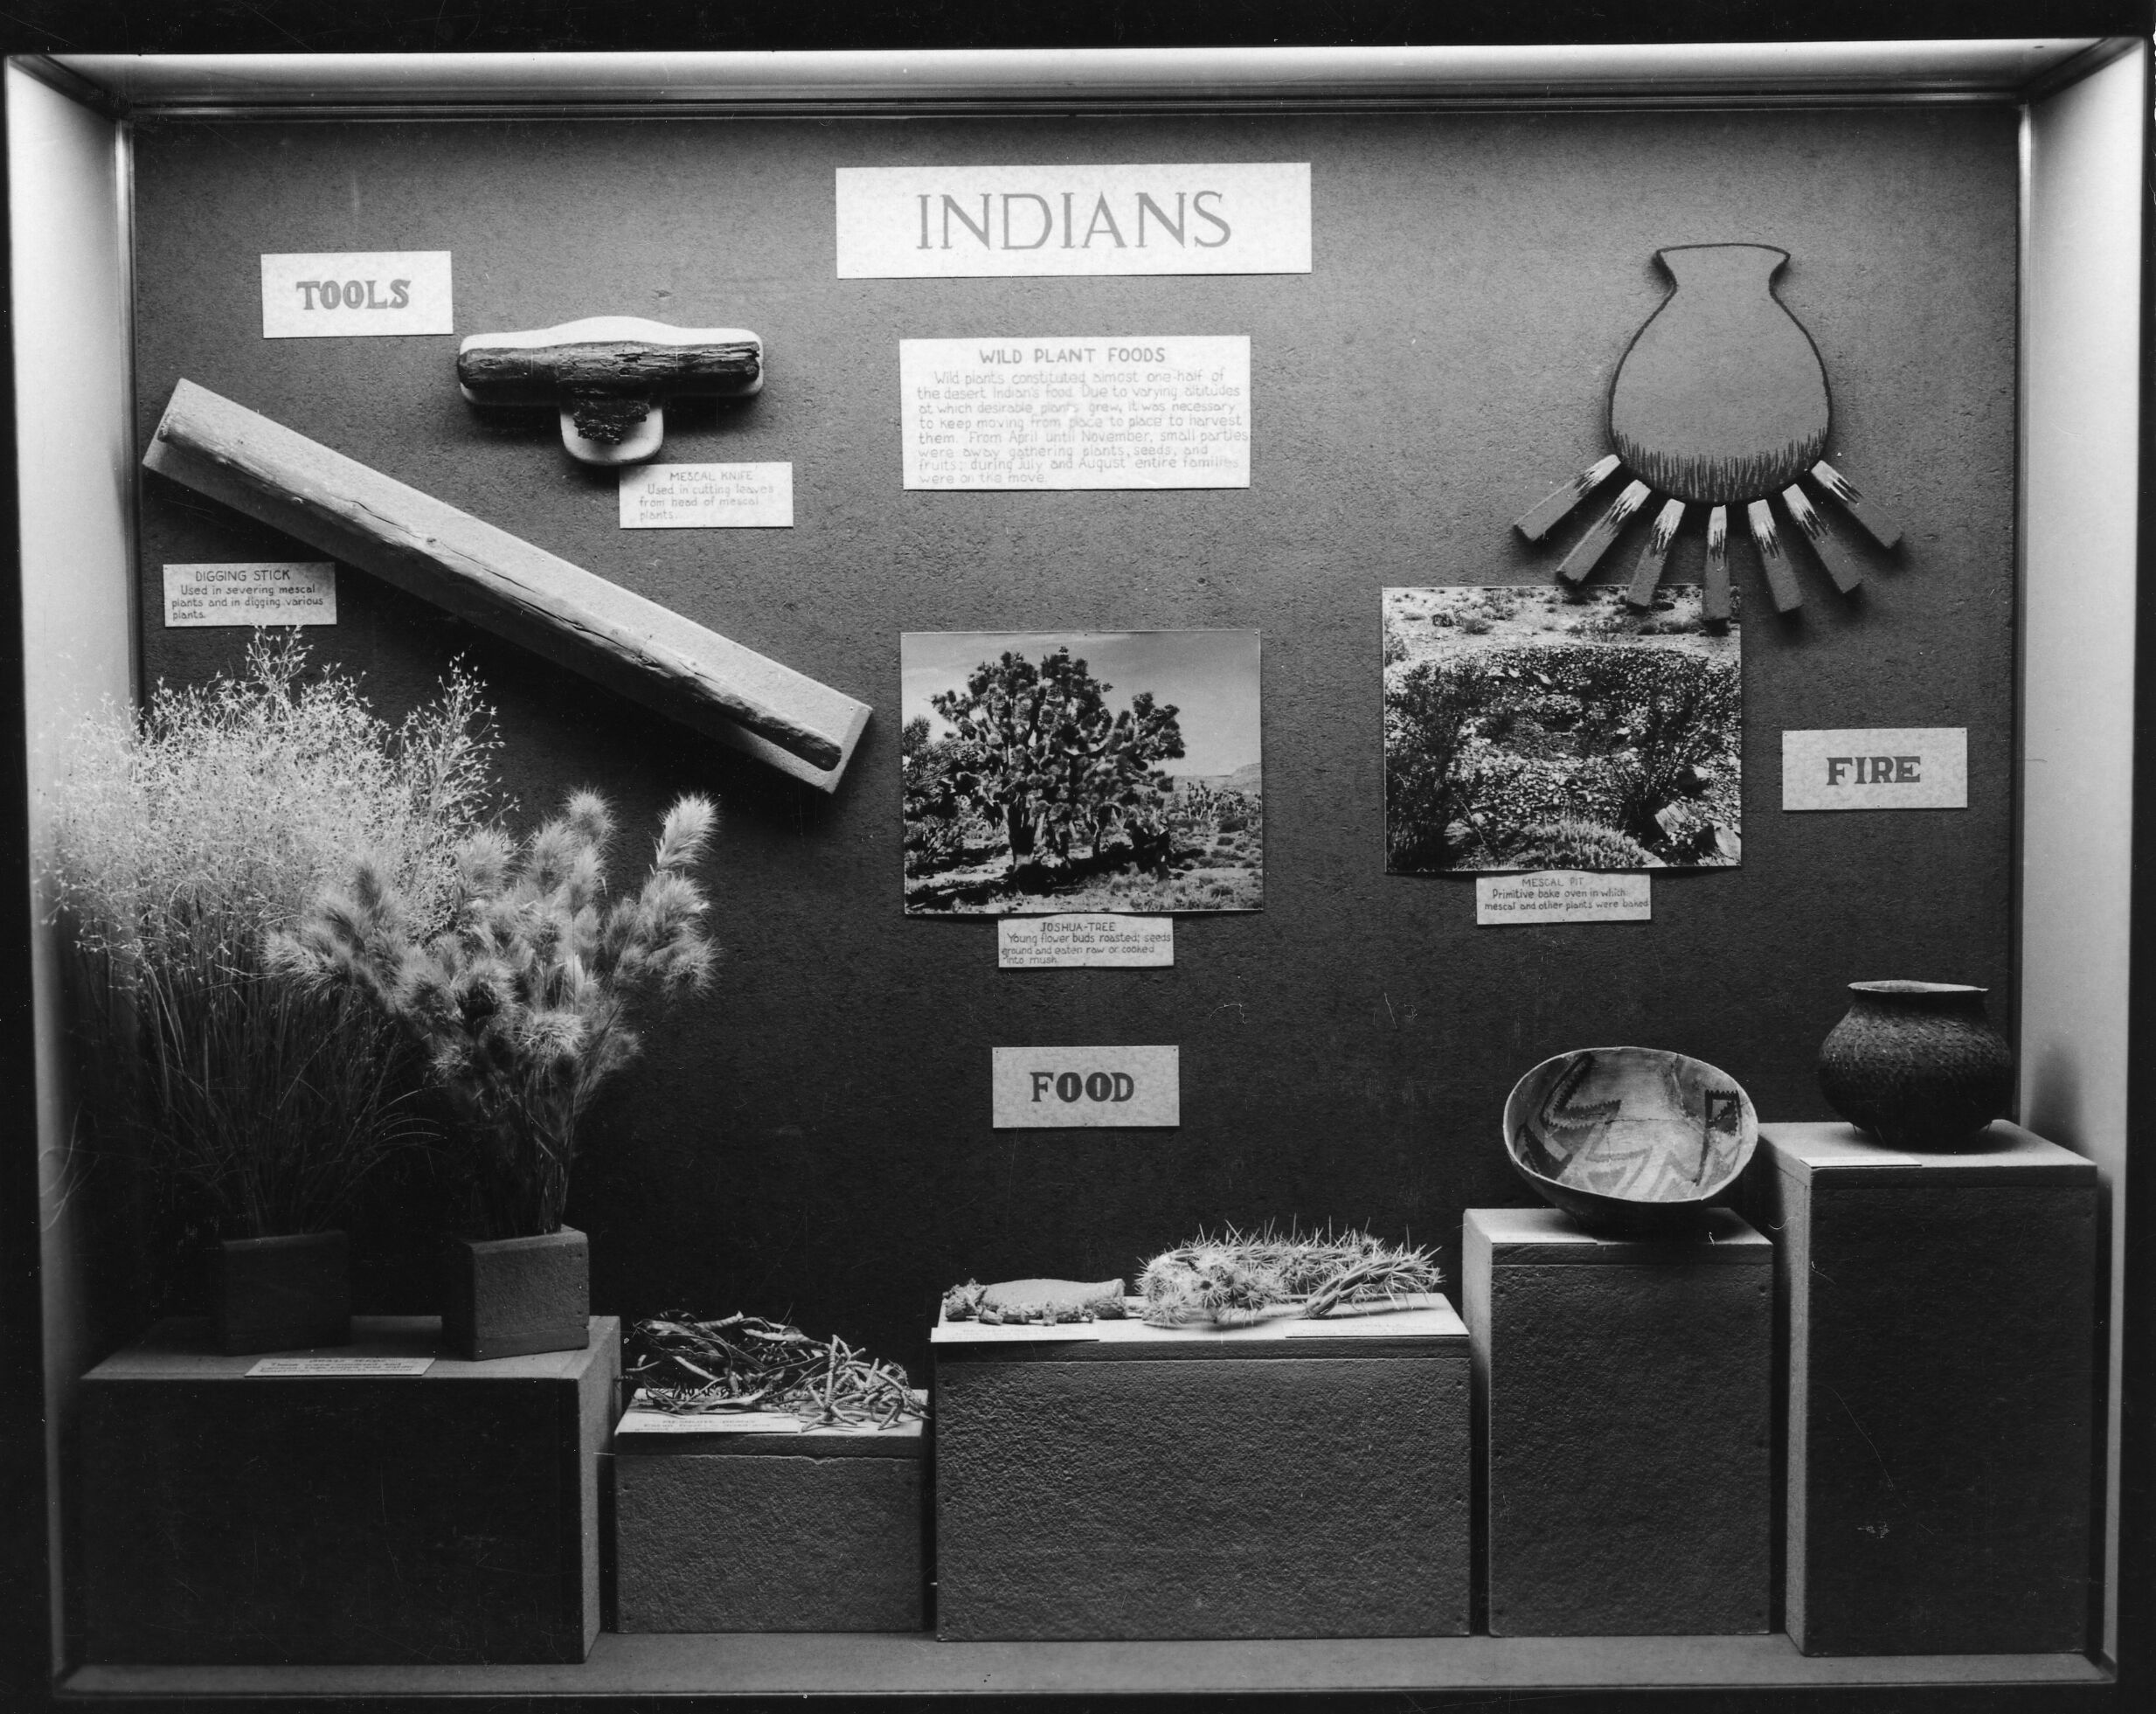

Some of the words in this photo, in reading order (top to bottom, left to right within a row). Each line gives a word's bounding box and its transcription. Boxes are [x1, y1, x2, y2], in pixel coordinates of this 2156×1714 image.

[917, 191, 1231, 250] INDIANS
[296, 279, 411, 310] TOOLS
[980, 350, 1022, 364] WILD
[1034, 348, 1096, 363] PLANT
[1108, 347, 1165, 363] FOODS
[934, 371, 960, 385] Wild
[965, 371, 1004, 386] plants
[1012, 371, 1085, 384] constituted
[1093, 370, 1138, 383] almost
[1147, 370, 1203, 382] one-half
[1212, 367, 1225, 382] of
[917, 387, 939, 399] the
[945, 387, 986, 399] desert
[994, 386, 1039, 399] Indian's
[1082, 385, 1107, 398] Due
[1113, 387, 1127, 397] to
[1133, 388, 1177, 400] varying
[1185, 385, 1240, 396] altitudes
[919, 405, 932, 414] at
[938, 403, 972, 413] which
[978, 403, 1032, 413] desirable
[1041, 402, 1078, 415] plants
[1089, 403, 1122, 416] grew,
[1128, 402, 1137, 412] it
[1172, 403, 1235, 413] necessary
[920, 420, 933, 429] to
[940, 419, 971, 431] keep
[977, 418, 1023, 431] moving
[1031, 414, 1060, 427] from
[1070, 417, 1102, 428] place
[1110, 418, 1124, 427] to
[1129, 415, 1162, 428] place
[1169, 416, 1182, 427] to
[1189, 414, 1242, 426] harvest
[919, 433, 958, 444] them.
[969, 433, 1002, 443] From
[1009, 430, 1038, 446] April
[1046, 431, 1075, 442] until
[1082, 431, 1153, 442] November,
[1161, 429, 1195, 441] small
[1200, 430, 1248, 443] parties
[963, 448, 1000, 459] away
[1009, 446, 1072, 460] gathering
[1083, 446, 1130, 457] plants,
[1134, 446, 1176, 455] seeds,
[1184, 446, 1208, 455] and
[971, 459, 1012, 474] during
[1050, 459, 1072, 469] and
[1135, 457, 1176, 468] entire
[669, 472, 715, 482] MESCAL
[721, 471, 753, 481] KNIFE
[919, 474, 954, 483] were
[960, 474, 974, 482] on
[980, 472, 1002, 482] the
[1009, 474, 1047, 483] move.
[648, 484, 674, 494] Used
[680, 484, 688, 494] in
[692, 484, 731, 496] cutting
[736, 483, 773, 494] leaves
[640, 496, 664, 506] from
[671, 496, 697, 506] head
[704, 496, 714, 506] of
[719, 496, 759, 505] mescal
[640, 510, 677, 522] plants.
[196, 571, 246, 581] DIGGING
[253, 569, 290, 581] STICK
[182, 585, 207, 595] Used
[212, 585, 221, 594] in
[226, 585, 274, 596] severing
[279, 584, 315, 593] mescal
[172, 599, 203, 609] plants
[209, 598, 227, 607] and
[232, 597, 240, 606] in
[245, 597, 281, 608] digging
[286, 597, 323, 606] various
[173, 610, 205, 621] plants.
[1827, 756, 1920, 785] FIRE
[1522, 878, 1563, 887] MESCAL
[1493, 889, 1534, 899] Primitive
[1601, 888, 1626, 897] which
[1539, 901, 1563, 910] other
[1566, 901, 1591, 911] plants
[1040, 922, 1115, 932] JOSHUA-TREE
[1007, 933, 1037, 946] Young
[1041, 933, 1070, 943] flower
[1072, 933, 1094, 942] buds
[1144, 933, 1170, 941] seeds
[1002, 946, 1032, 958] ground
[1029, 1072, 1133, 1103] FOOD
